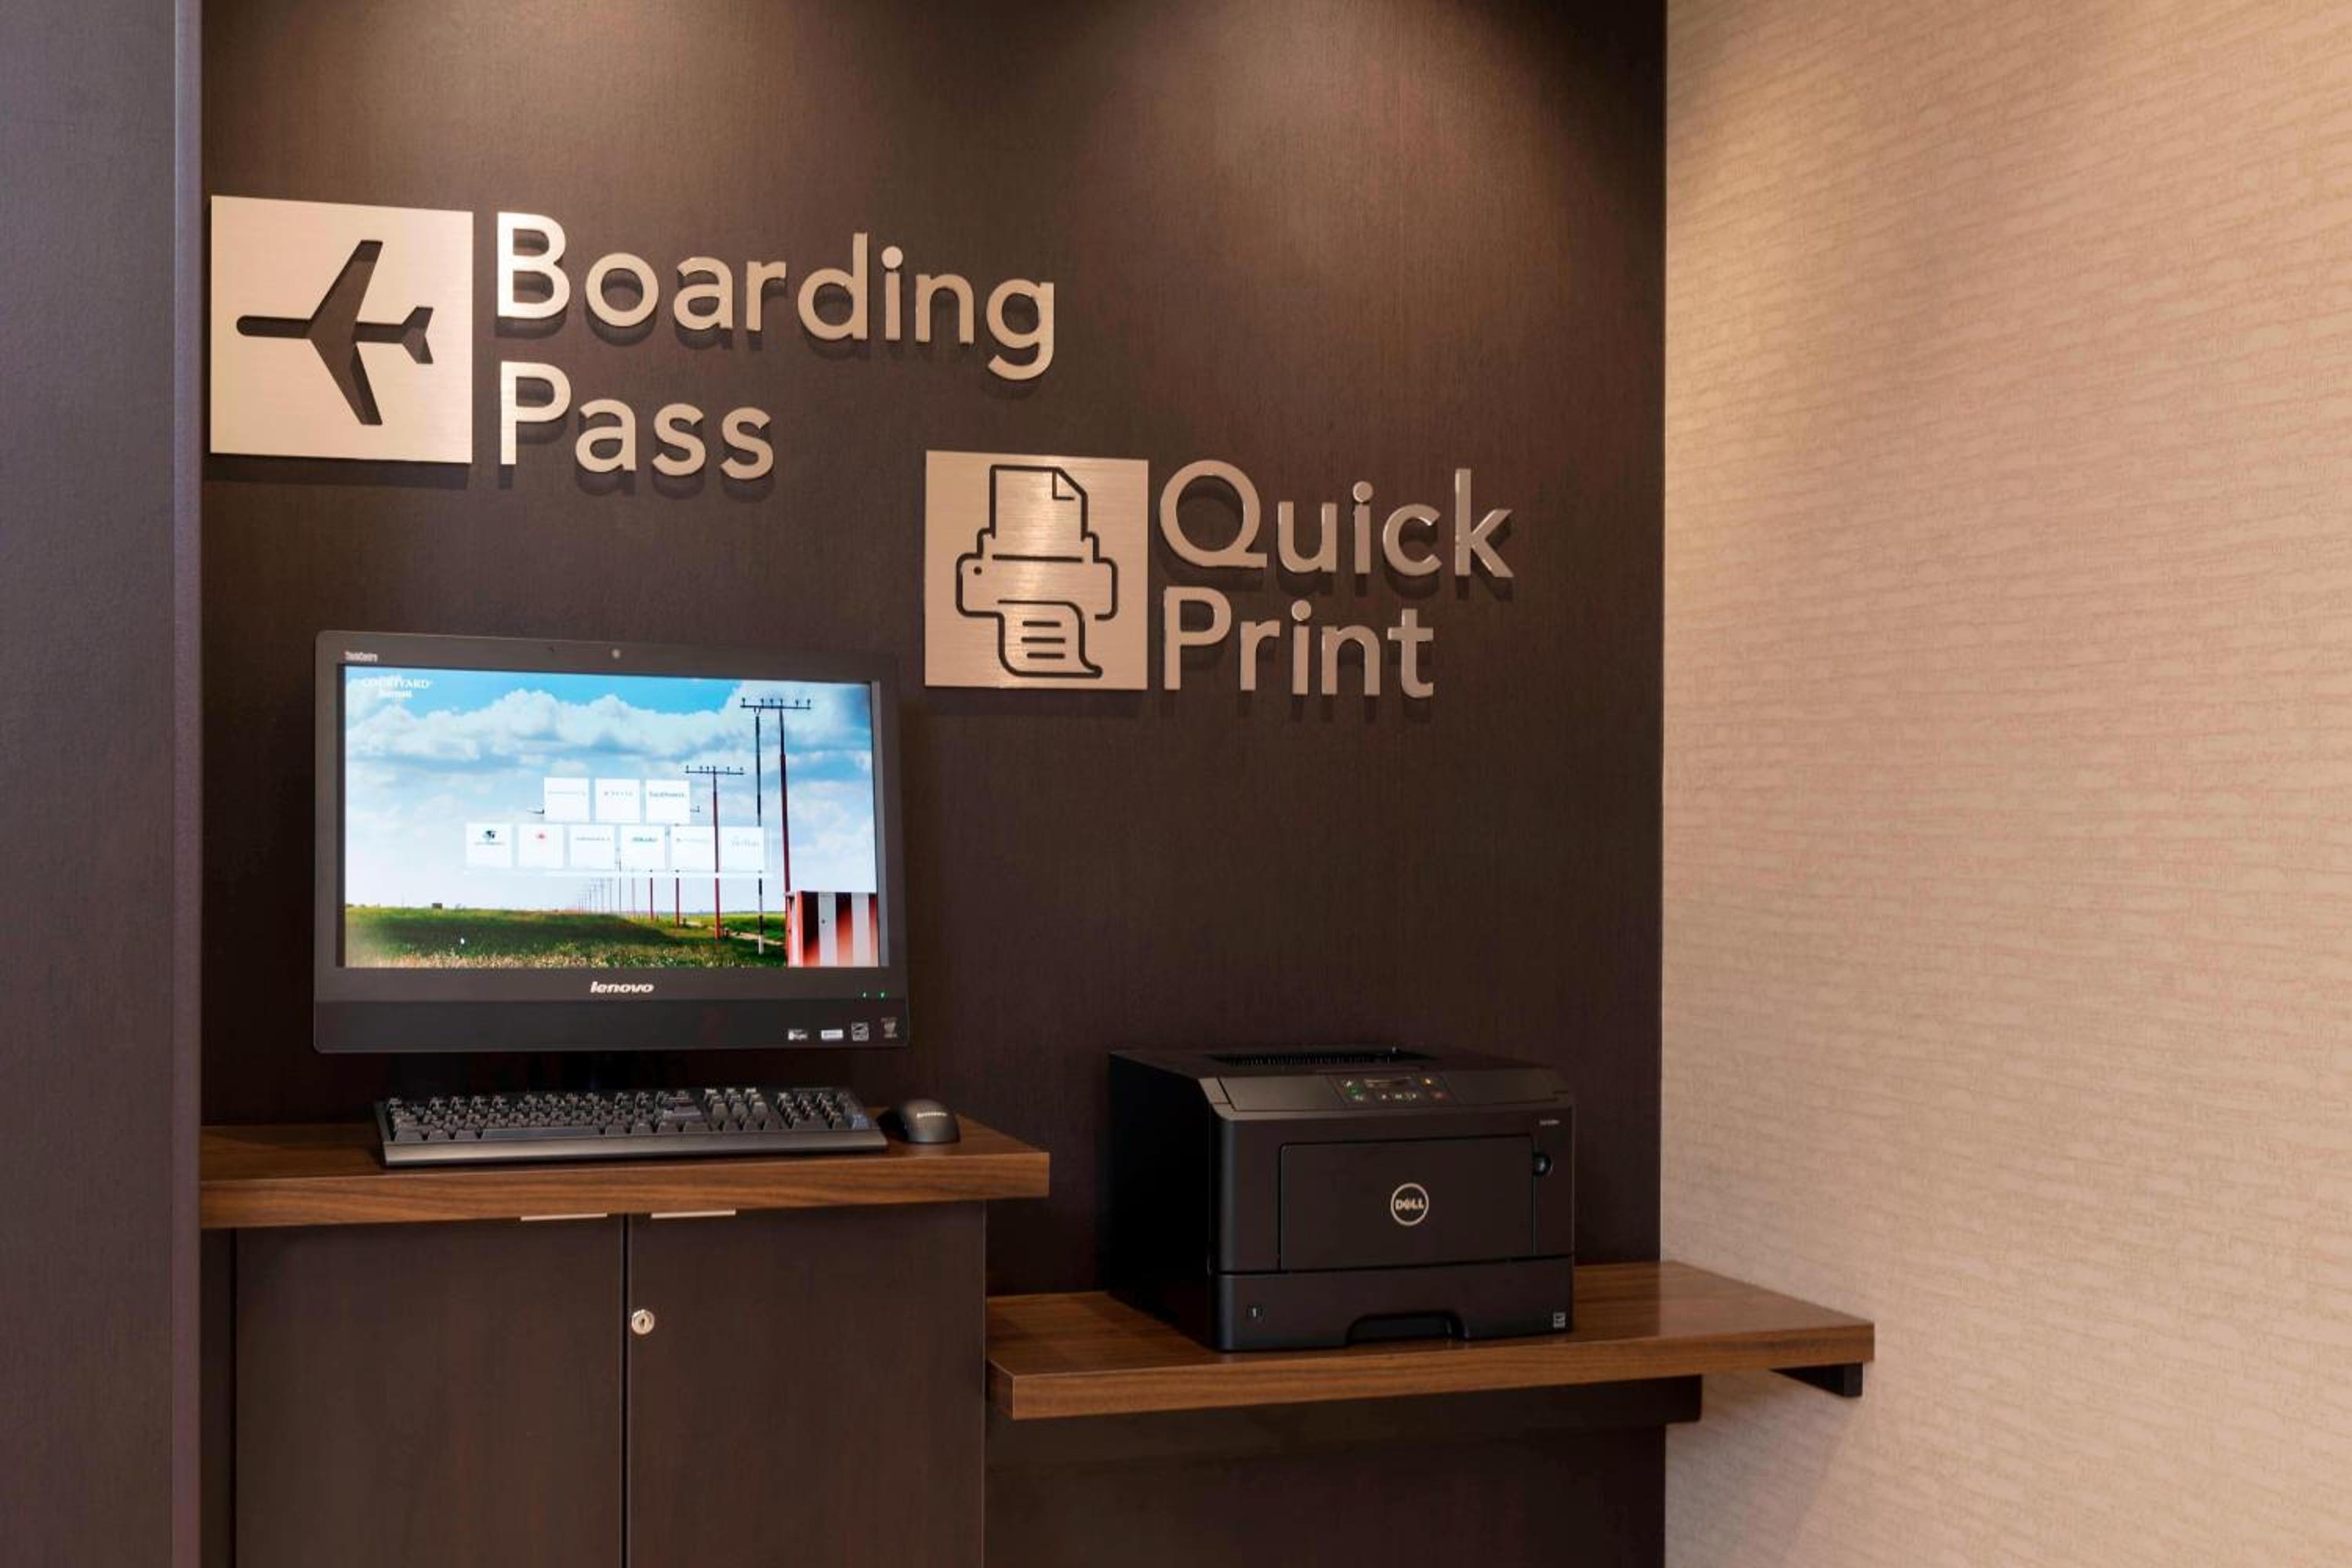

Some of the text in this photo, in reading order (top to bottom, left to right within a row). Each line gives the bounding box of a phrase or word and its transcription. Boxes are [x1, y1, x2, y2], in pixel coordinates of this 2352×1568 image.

[496, 211, 1054, 380] Boarding
[499, 360, 775, 480] Pass
[1160, 459, 1515, 578] Quick
[1163, 586, 1434, 699] Print
[590, 981, 655, 993] lenovo
[1395, 1198, 1425, 1210] DELL
